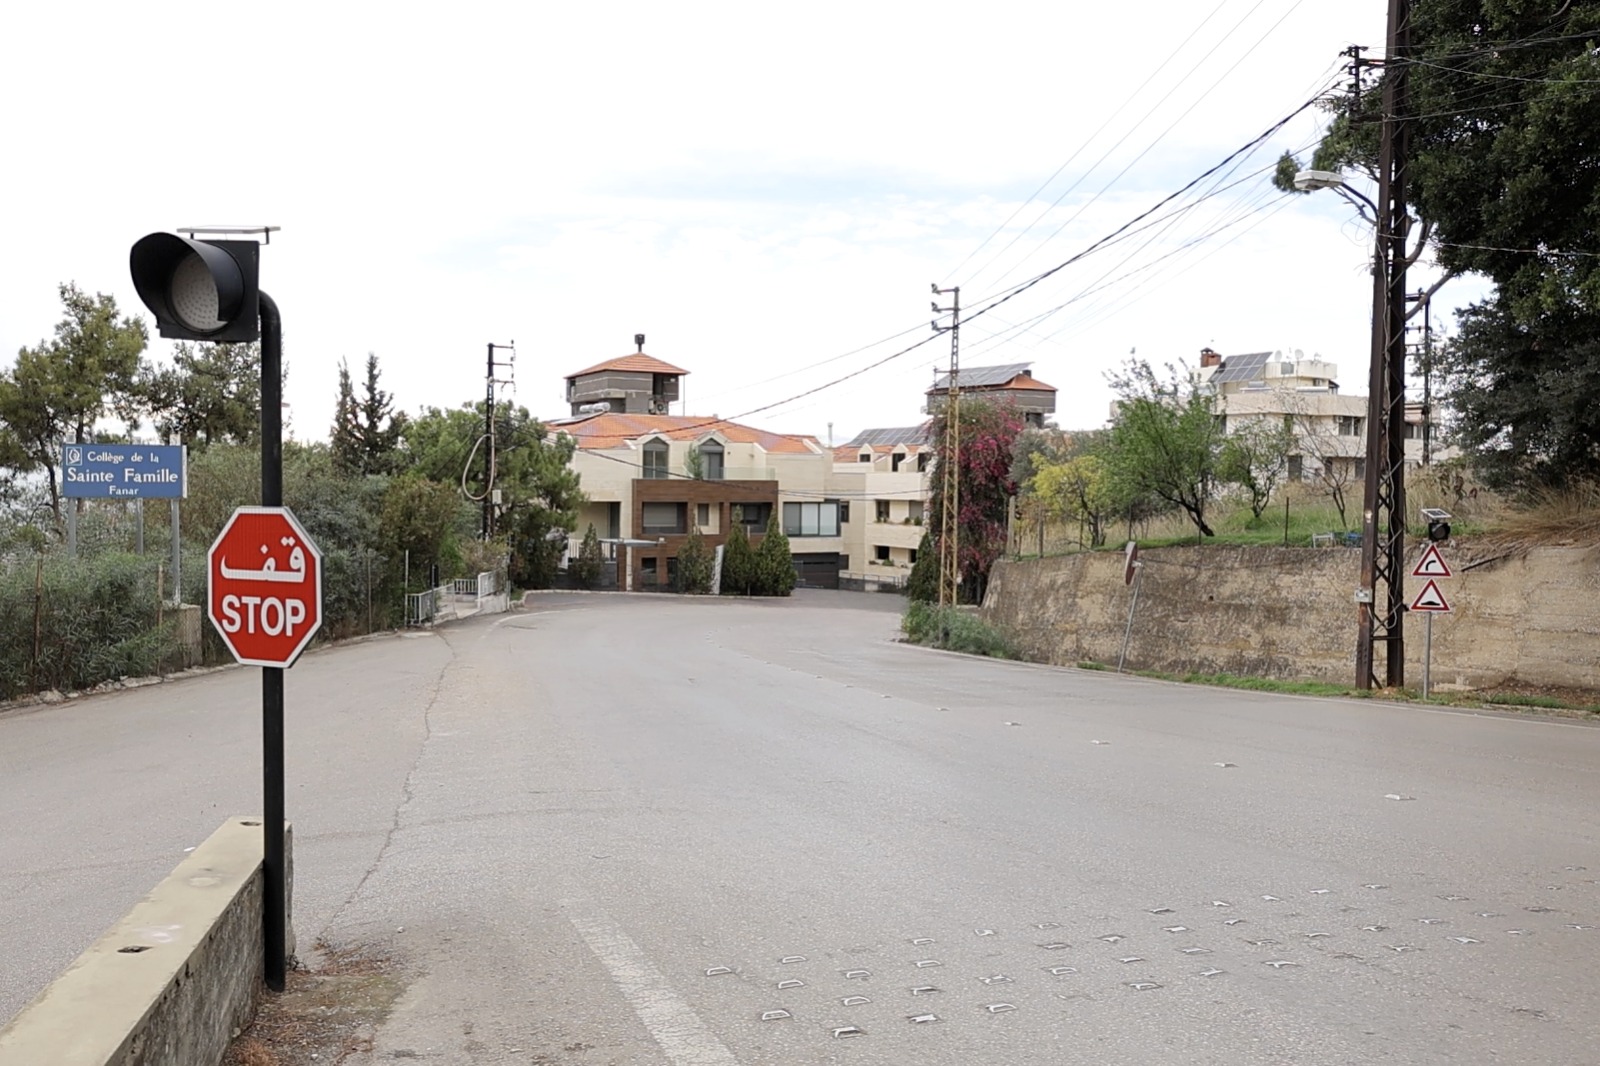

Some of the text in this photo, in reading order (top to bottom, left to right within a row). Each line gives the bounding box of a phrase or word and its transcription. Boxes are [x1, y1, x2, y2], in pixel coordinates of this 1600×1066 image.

[87, 451, 159, 464] Collège de la
[67, 467, 178, 482] Sainte Famille
[109, 485, 139, 495] Fanar
[220, 536, 306, 583] قف
[221, 594, 306, 637] STOP
